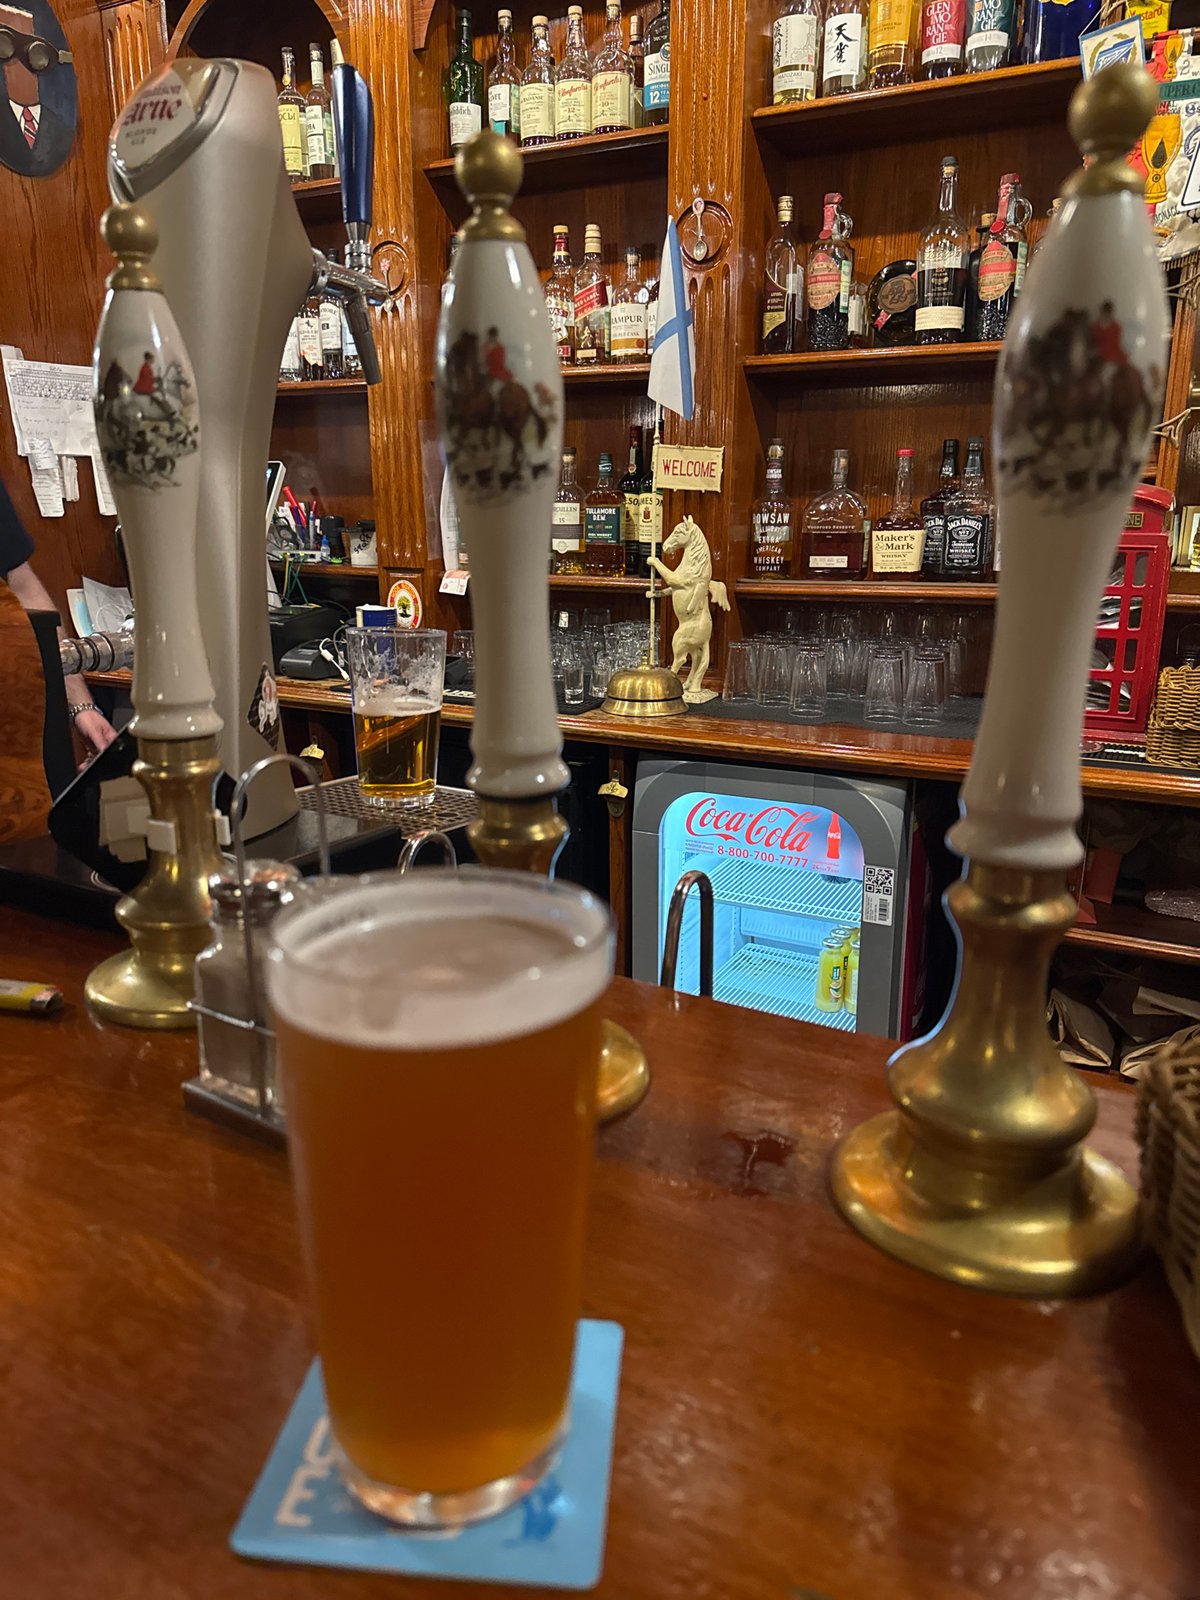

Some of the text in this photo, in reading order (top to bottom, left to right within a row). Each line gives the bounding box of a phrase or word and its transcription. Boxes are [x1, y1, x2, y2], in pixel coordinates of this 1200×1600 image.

[926, 1, 951, 17] GLEN
[975, 9, 994, 22] RAN
[934, 12, 951, 23] MO
[926, 24, 945, 37] RAN
[980, 19, 997, 31] GIE
[932, 32, 948, 45] GIE
[649, 91, 660, 105] 12
[662, 458, 718, 478] WELCOME
[586, 507, 616, 515] TULLAMORE
[947, 519, 961, 531] JACK
[875, 533, 916, 542] Maker's
[885, 542, 914, 551] Mark
[753, 556, 785, 564] WHISKEY
[685, 797, 820, 852] Coca-Cola
[717, 845, 809, 868] 8-800-700-7777
